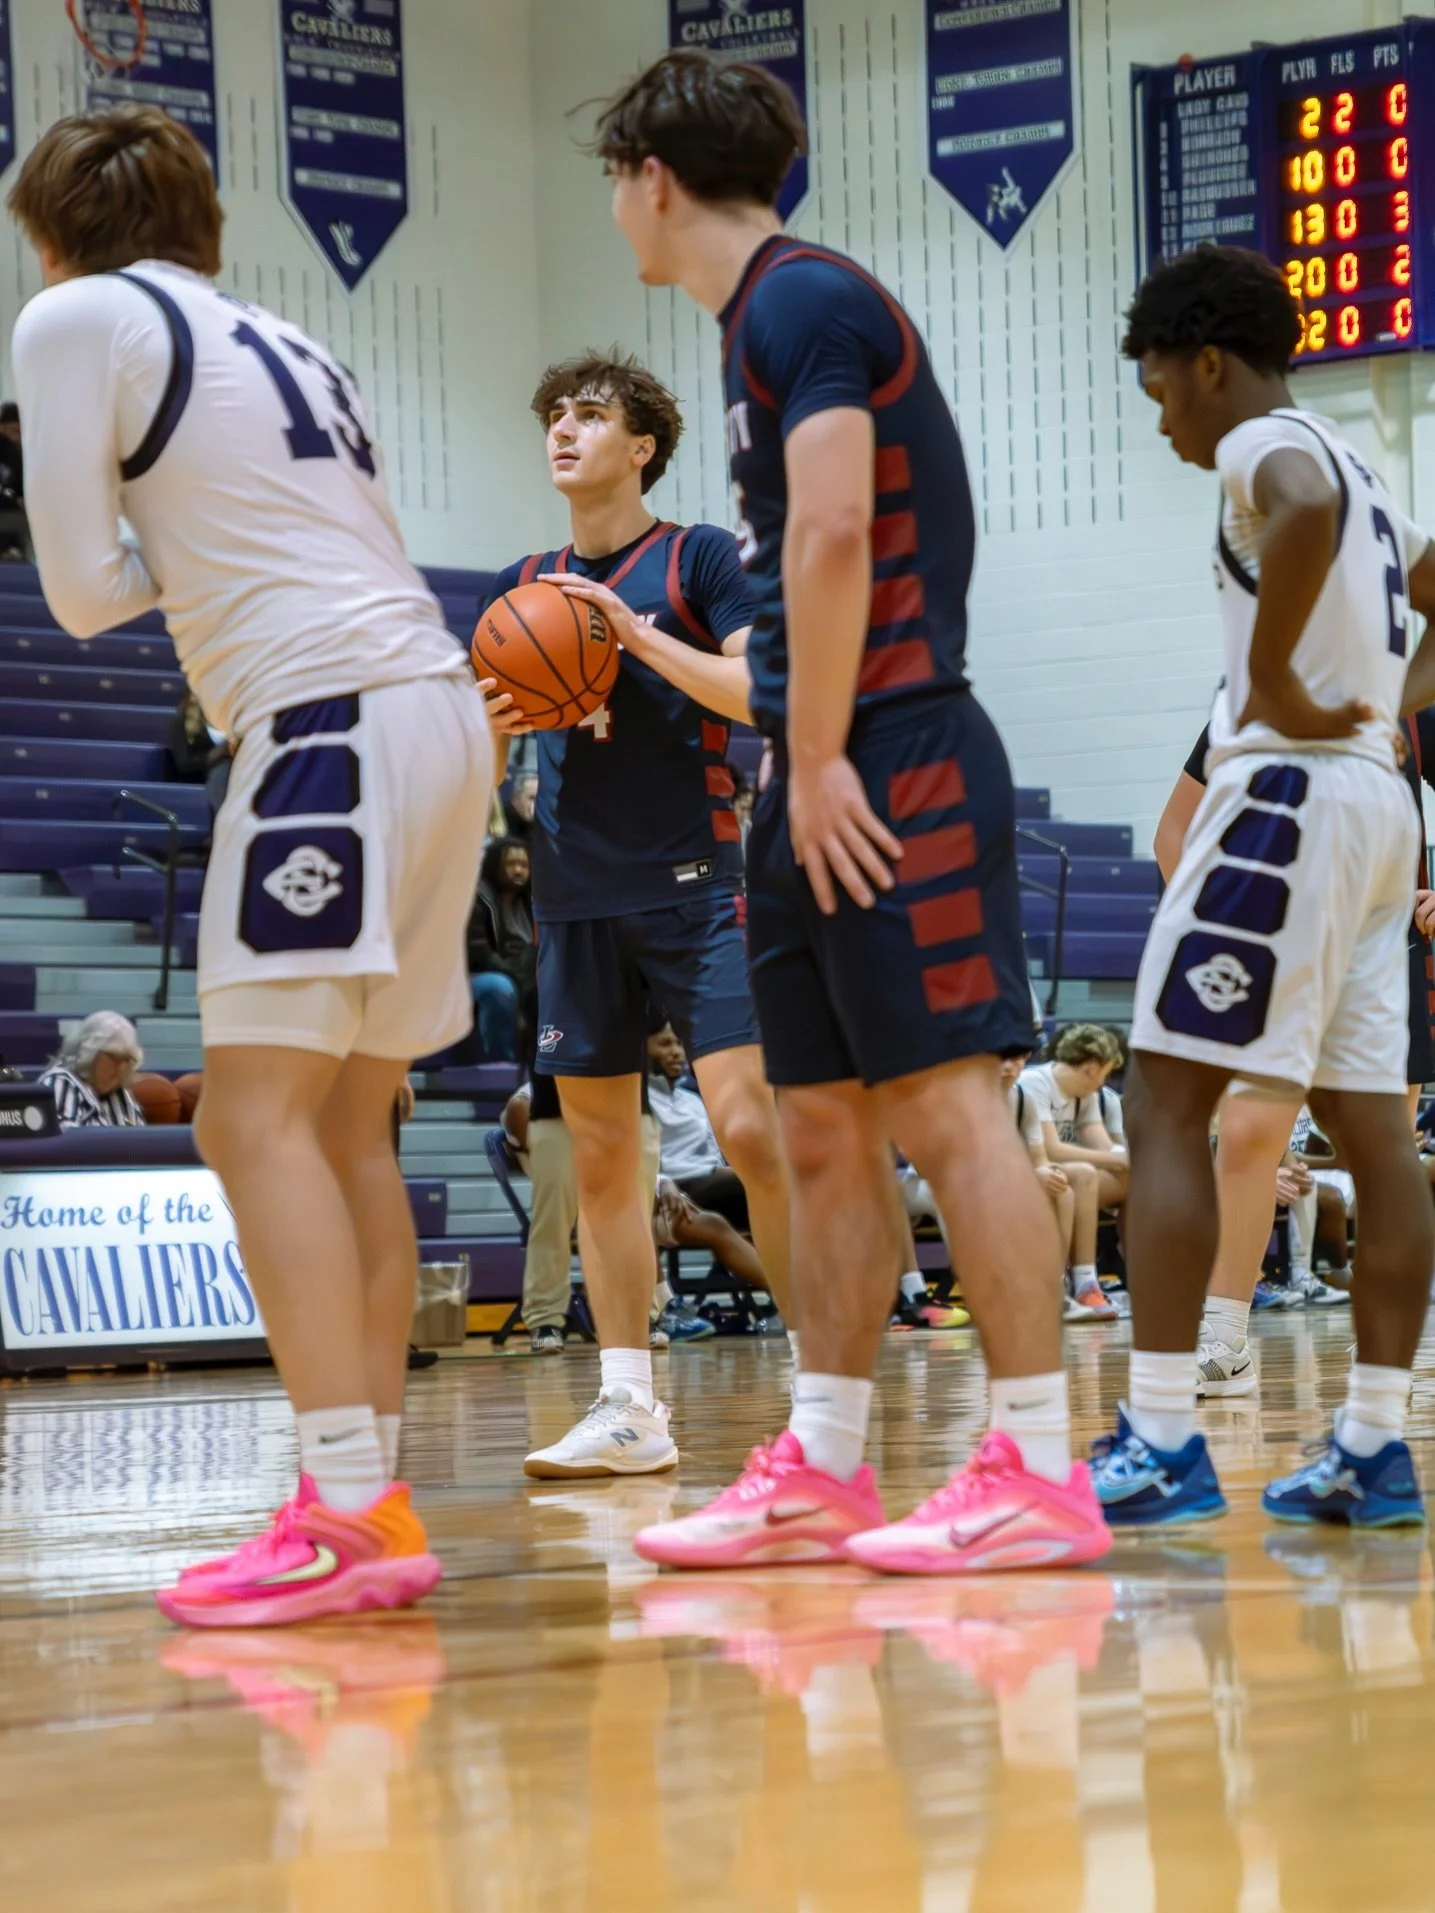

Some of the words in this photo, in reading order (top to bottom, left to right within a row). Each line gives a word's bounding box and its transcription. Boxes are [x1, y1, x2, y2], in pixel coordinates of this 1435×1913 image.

[681, 8, 793, 42] CAVALIERS
[1174, 64, 1236, 95] PLAYER
[1282, 57, 1317, 83] PLYR
[1331, 50, 1355, 75] FLS
[1373, 43, 1399, 69] PTS
[1301, 97, 1321, 139] 2
[1334, 92, 1354, 134] 2
[1388, 83, 1407, 124] 0
[1289, 150, 1323, 193] 10
[1336, 146, 1355, 184] 0
[1390, 137, 1408, 178] 0
[1291, 203, 1325, 244] 13
[1337, 199, 1357, 239] 0
[1393, 191, 1409, 232] 3
[1286, 257, 1326, 297] 20
[1338, 252, 1358, 292] 0
[1393, 244, 1410, 284] 2
[1340, 305, 1359, 347] 0
[1393, 297, 1411, 338] 0
[229, 318, 377, 481] 13
[1370, 502, 1407, 660] 2
[0, 1110, 23, 1126] NUS
[1, 1195, 106, 1230] Home
[117, 1193, 154, 1235] of
[164, 1192, 214, 1224] the
[3, 1240, 256, 1336] CAVALIERS
